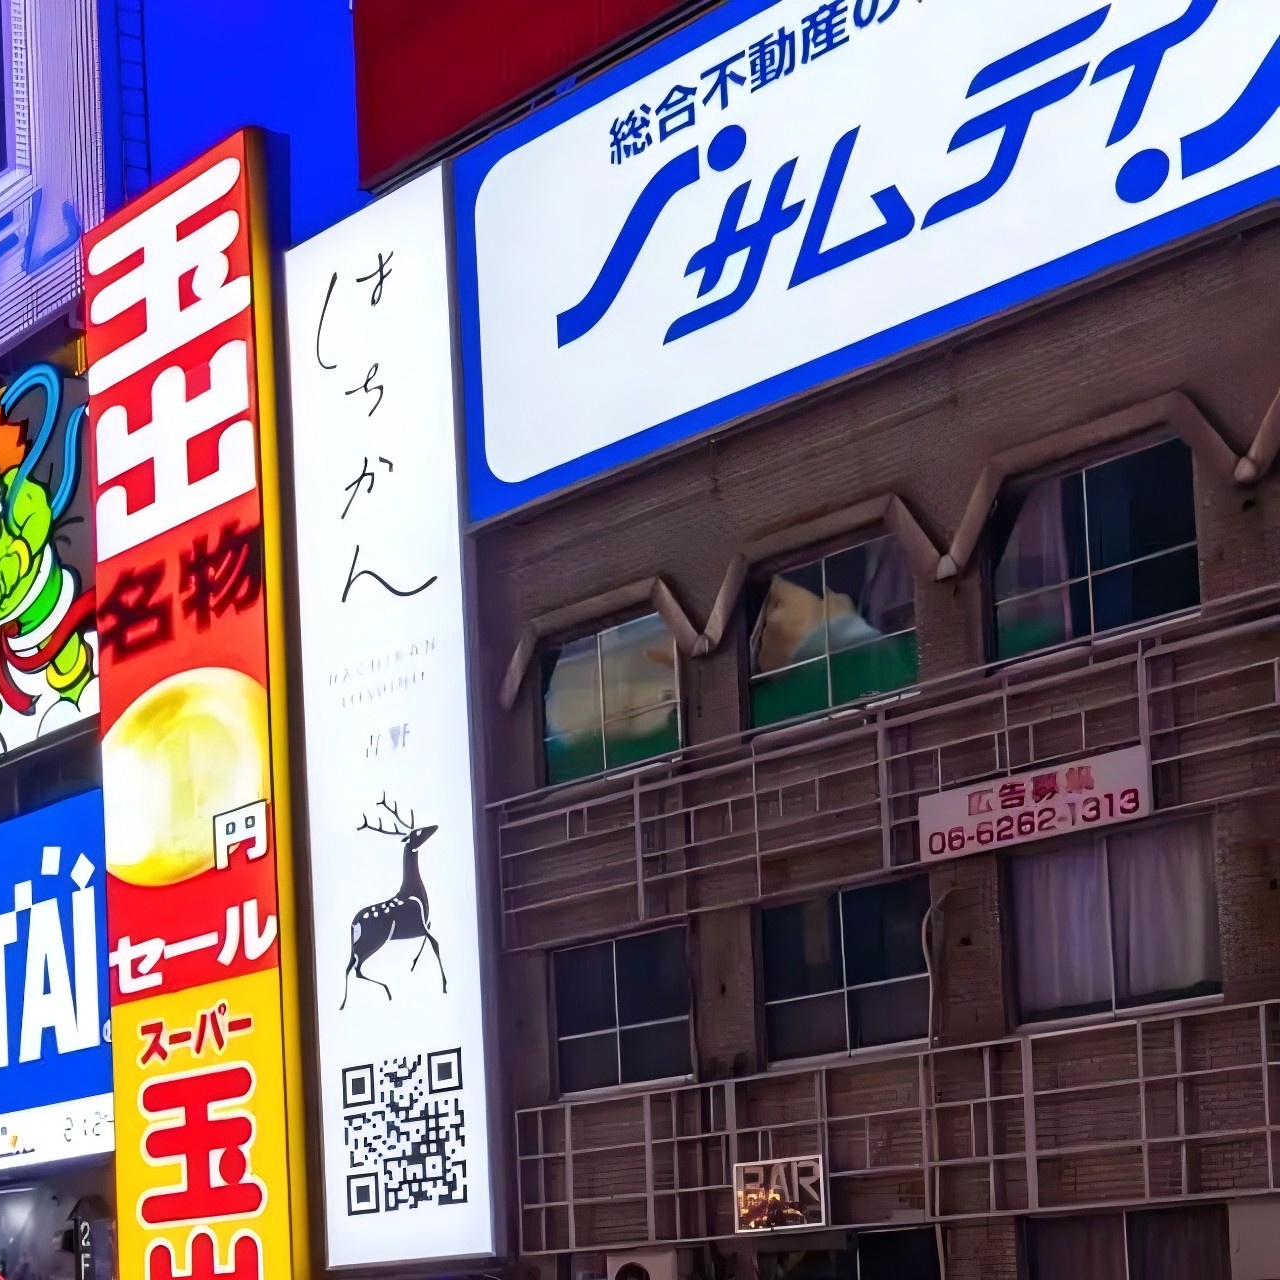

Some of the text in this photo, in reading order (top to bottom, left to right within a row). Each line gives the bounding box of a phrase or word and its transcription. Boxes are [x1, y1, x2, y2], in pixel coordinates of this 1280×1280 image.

[609, 0, 924, 164] 総合不動産の
[88, 157, 257, 562] 玉出
[316, 251, 438, 603] はちかん
[96, 528, 262, 664] 名物
[109, 898, 278, 994] セール
[140, 1003, 253, 1066] スーパー
